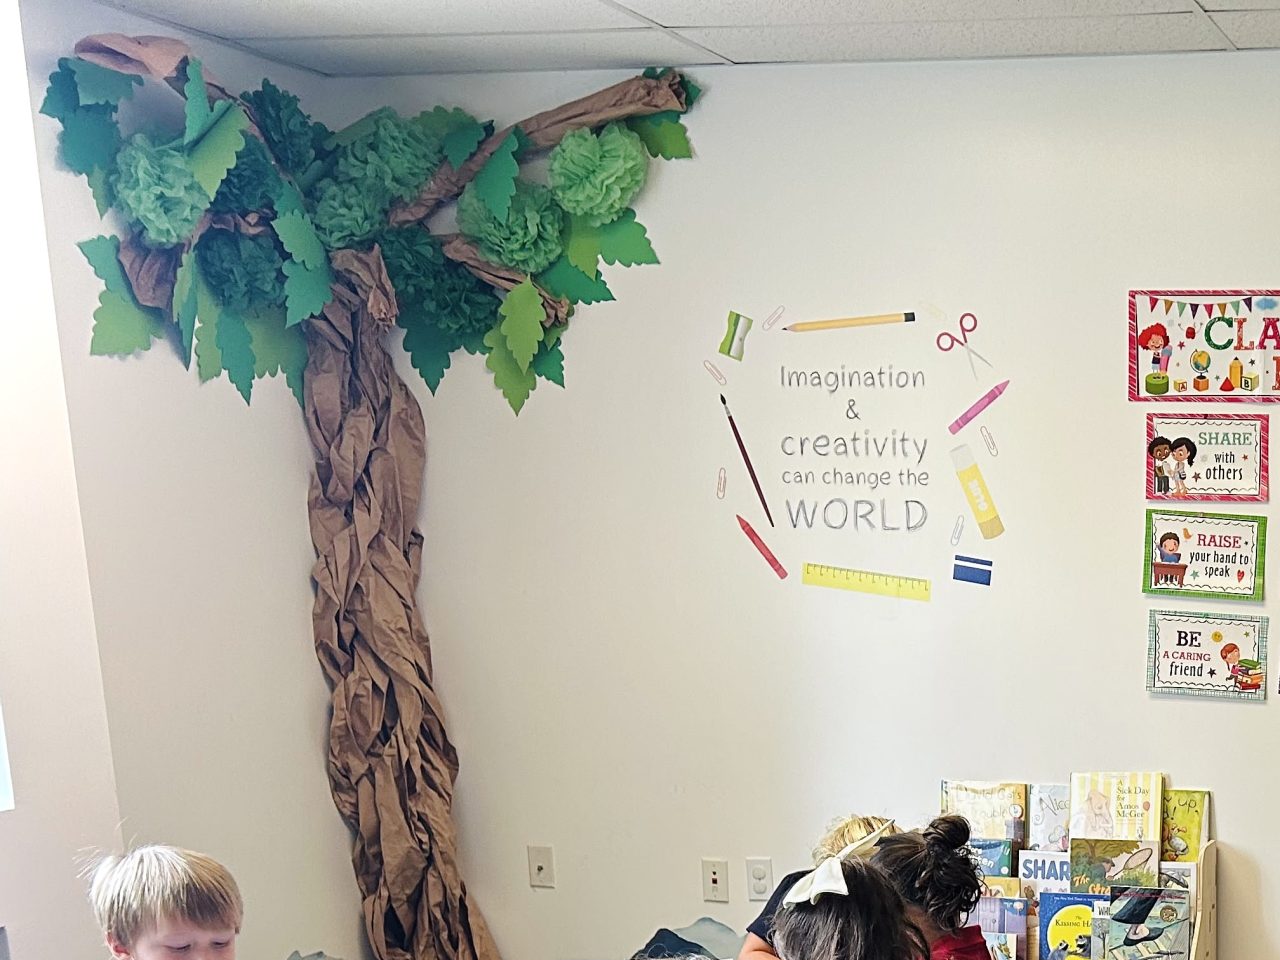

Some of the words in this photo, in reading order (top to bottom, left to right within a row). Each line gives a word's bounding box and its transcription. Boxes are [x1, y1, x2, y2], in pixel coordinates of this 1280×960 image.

[780, 364, 925, 394] Imagination
[846, 398, 861, 420] &
[781, 429, 928, 464] creativity
[1198, 432, 1252, 446] SHARE
[1214, 451, 1235, 464] with
[781, 470, 815, 484] can
[821, 467, 891, 490] change
[899, 468, 929, 486] the
[1205, 464, 1243, 481] others
[786, 497, 928, 531] WORLD
[1197, 533, 1242, 549] RAISE
[1189, 551, 1209, 564] your
[1213, 550, 1236, 565] hand
[1239, 553, 1249, 566] to
[1204, 565, 1230, 579] speak
[1176, 630, 1202, 647] BE
[1163, 650, 1170, 659] A
[1171, 651, 1211, 662] CARING
[1169, 661, 1204, 678] friend
[1117, 786, 1131, 794] Sick
[1134, 786, 1150, 797] Day
[1116, 802, 1140, 810] Amos
[1116, 810, 1145, 818] McGee
